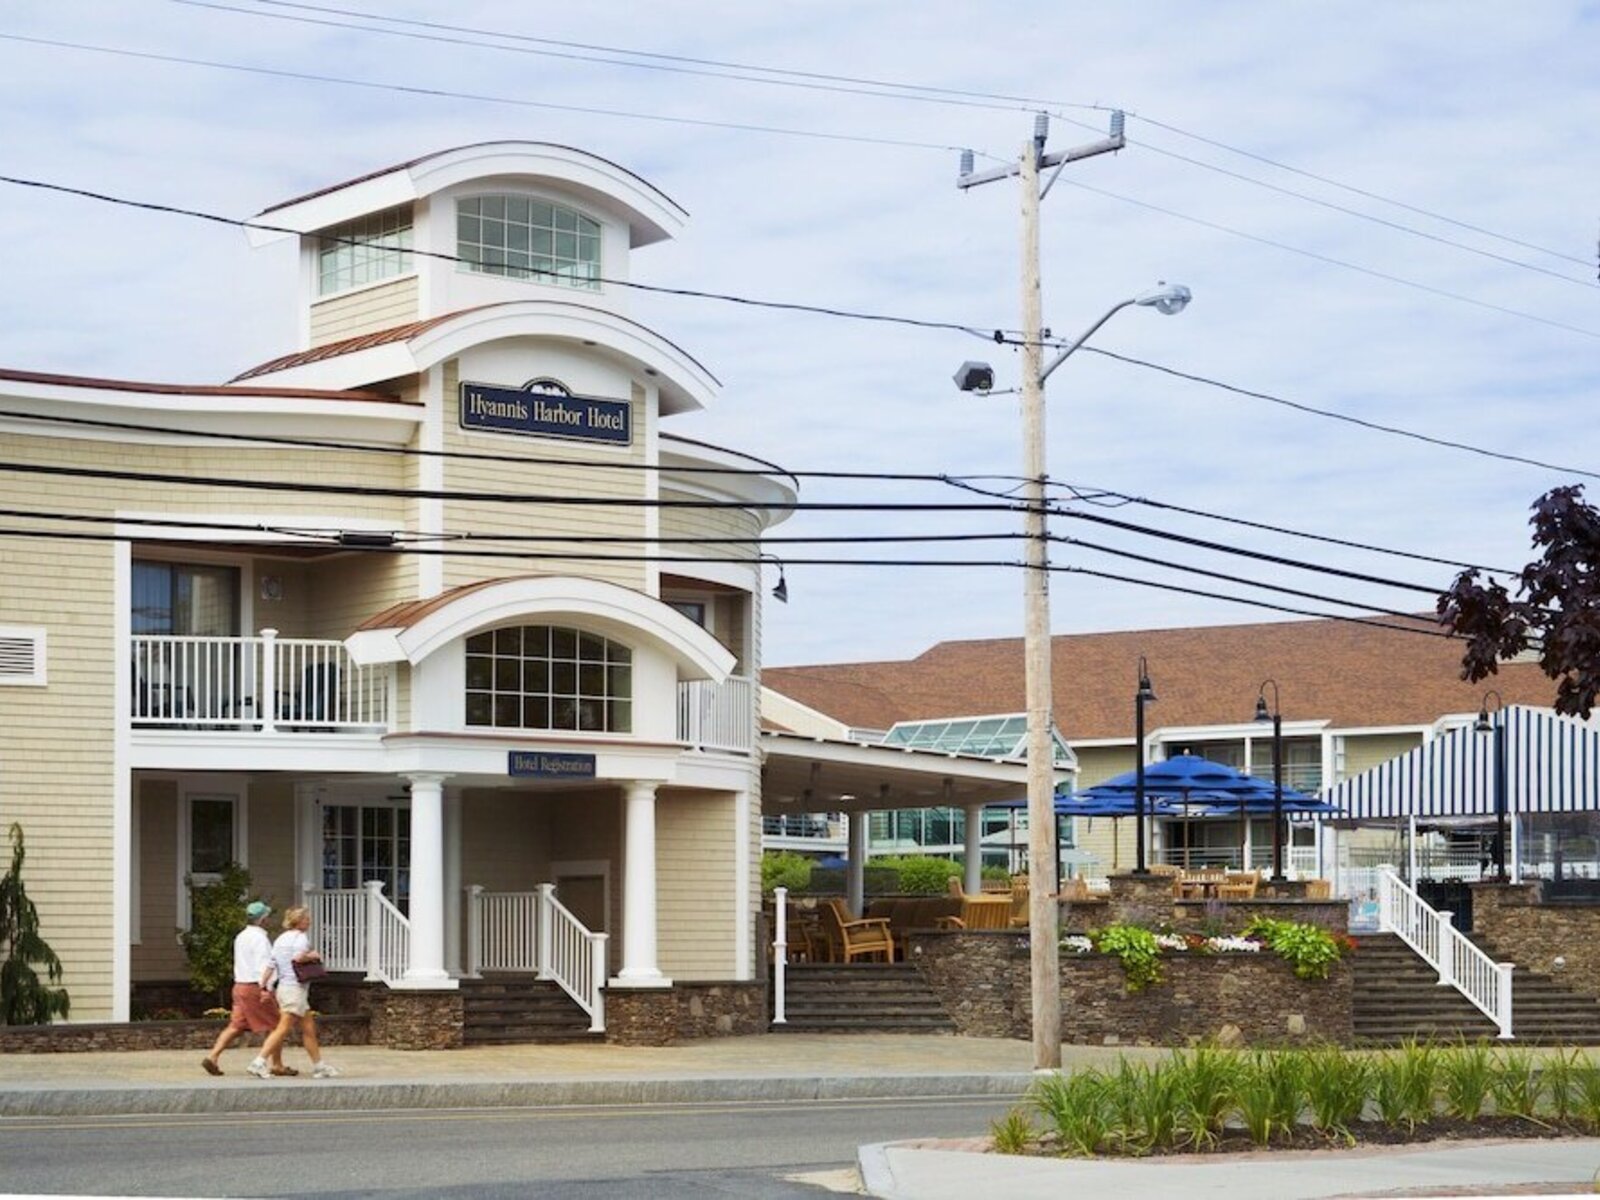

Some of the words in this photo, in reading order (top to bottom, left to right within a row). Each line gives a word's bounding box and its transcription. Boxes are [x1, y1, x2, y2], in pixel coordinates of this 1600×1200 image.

[470, 393, 529, 419] Hyannis
[534, 401, 583, 425] Harbor
[588, 407, 625, 431] Hotel
